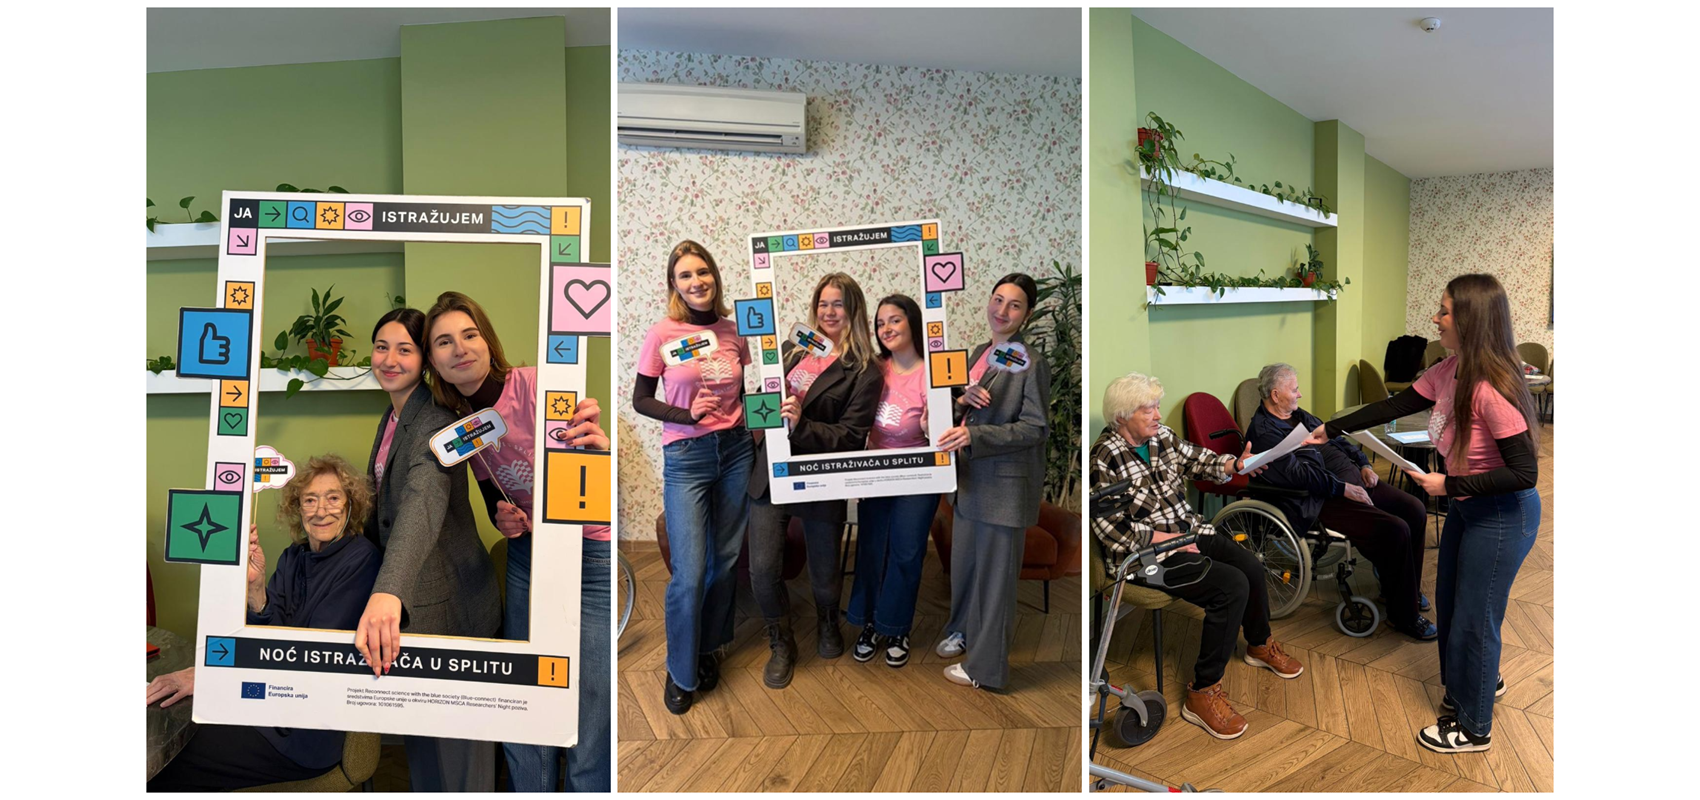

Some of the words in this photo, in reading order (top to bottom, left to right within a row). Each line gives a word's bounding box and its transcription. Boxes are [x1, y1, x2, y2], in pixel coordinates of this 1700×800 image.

[234, 207, 252, 218] JA
[382, 208, 484, 224] ISTRAŽUJEM
[833, 232, 888, 243] ISTRAŽUJEM
[800, 463, 819, 472] NOĆ
[822, 459, 881, 470] ISTRAŽIVAČA
[893, 457, 924, 465] SPLITU
[260, 646, 297, 662] NOĆ
[431, 657, 441, 670] U
[448, 659, 513, 675] SPLITU
